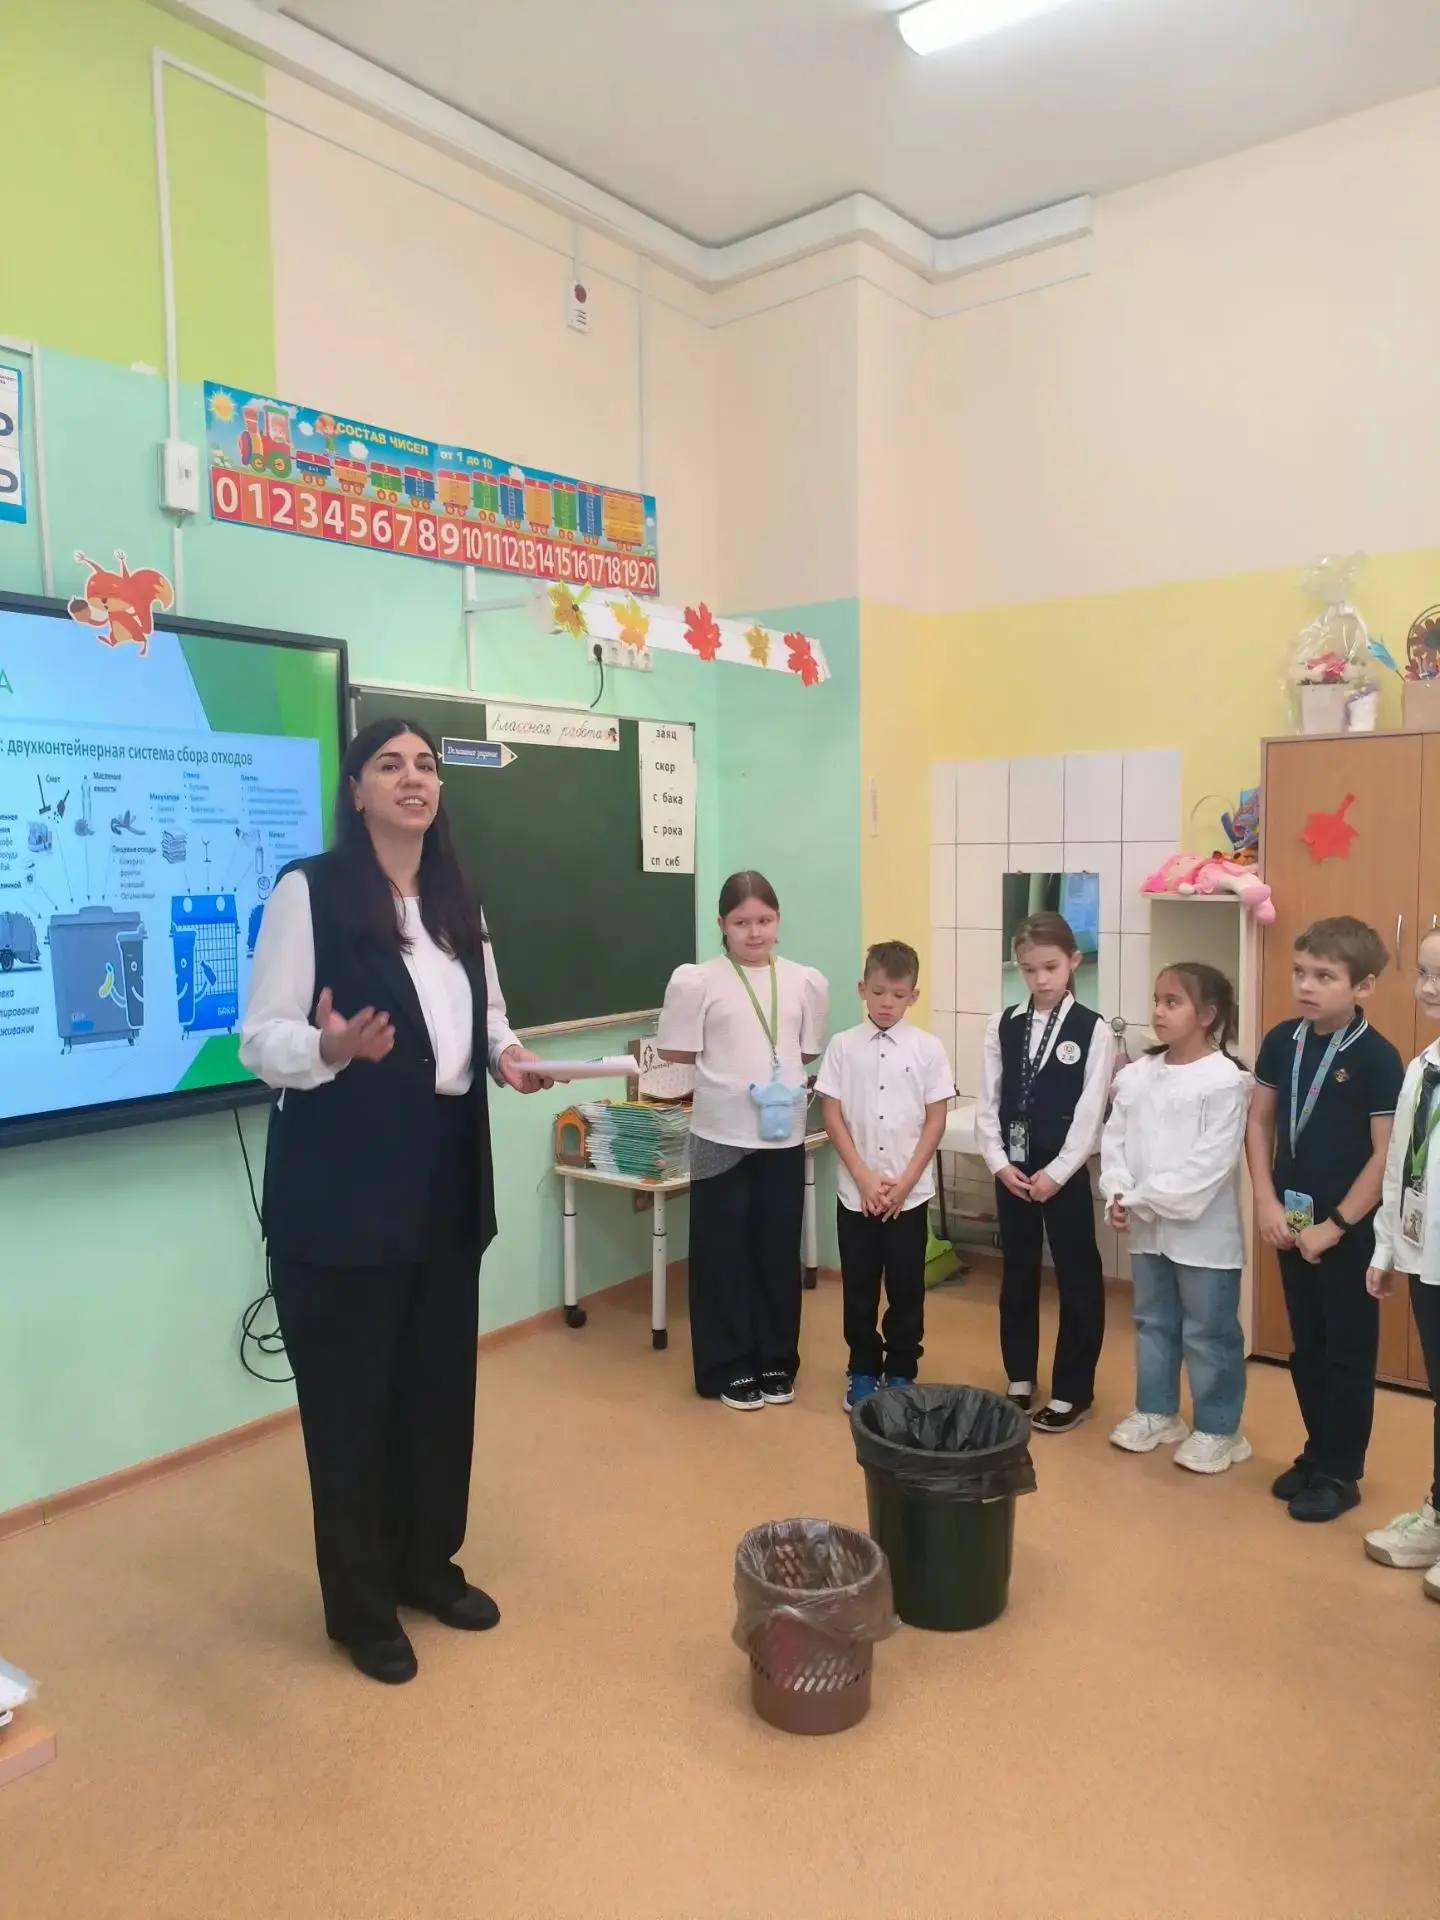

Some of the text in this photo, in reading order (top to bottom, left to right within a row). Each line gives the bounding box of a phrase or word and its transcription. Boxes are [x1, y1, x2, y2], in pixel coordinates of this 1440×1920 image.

[337, 423, 493, 469] СОСТАВ ЧИСЕЛ от 1 до 10
[216, 477, 656, 589] 0 1 2 3 4 5 6 7 8 9 10 11 12 13 14 15 16 17 18 19 20
[491, 711, 602, 744] Классная работа
[656, 729, 677, 740] заяц
[7, 739, 253, 768] двухконтейнерная система сбора отходов
[655, 761, 676, 774] скор
[653, 792, 683, 805] с бака
[653, 825, 683, 836] с рока
[651, 856, 680, 866] сп сиб
[217, 1006, 236, 1016] БАКА
